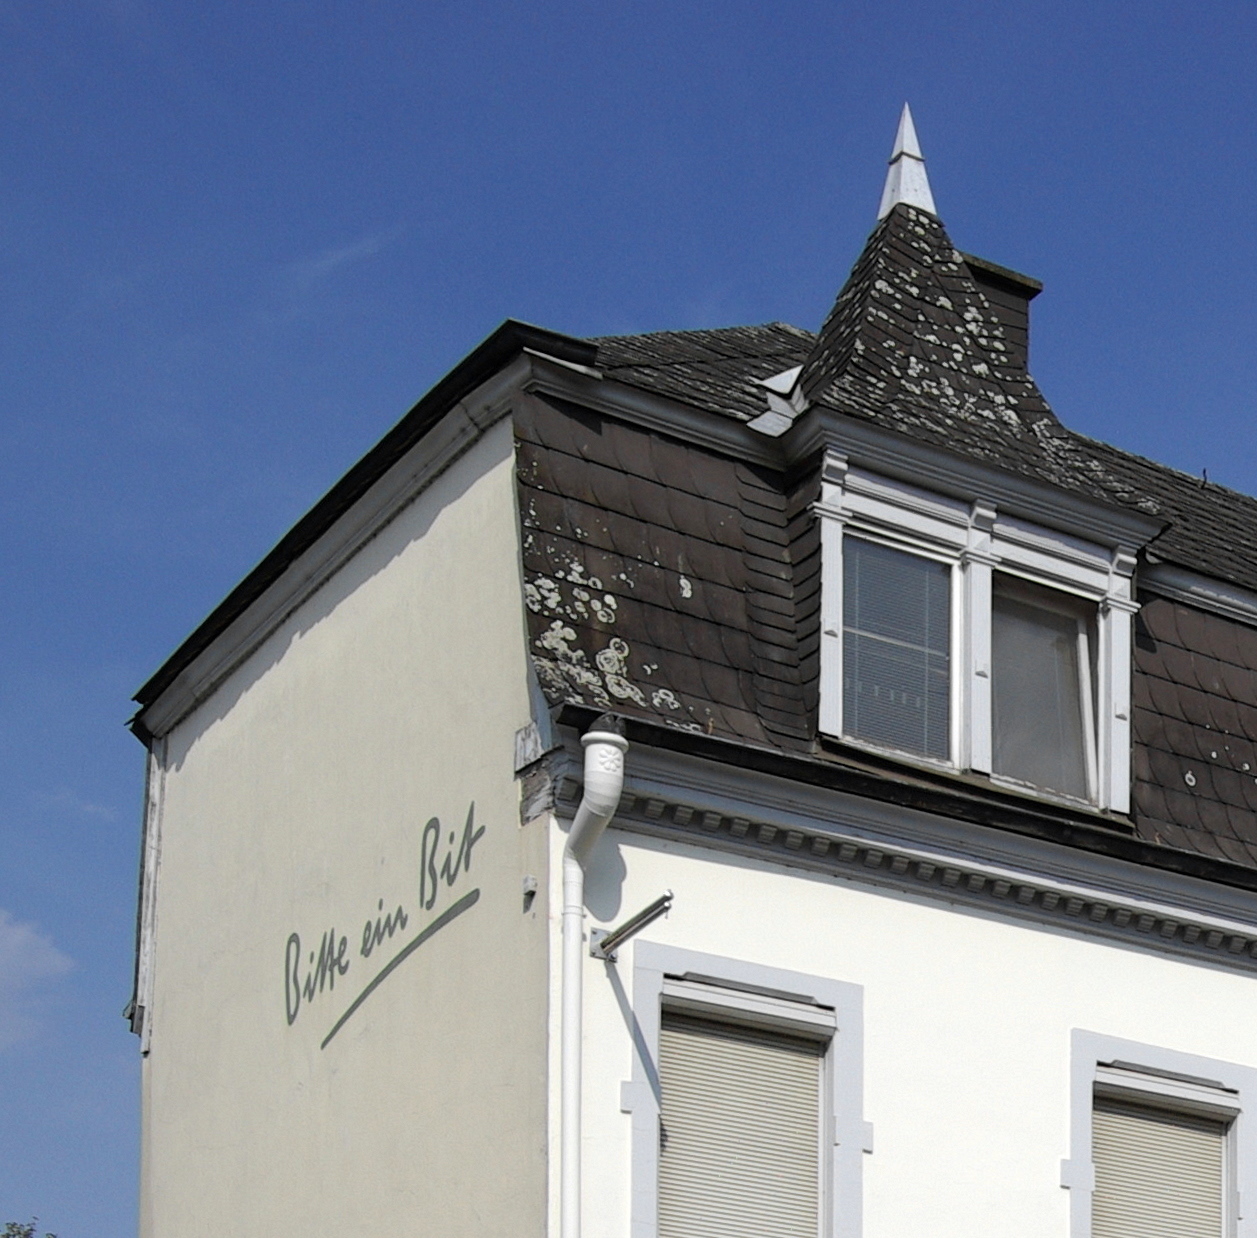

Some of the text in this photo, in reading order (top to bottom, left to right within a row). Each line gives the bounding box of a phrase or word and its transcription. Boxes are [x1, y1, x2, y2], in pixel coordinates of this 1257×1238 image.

[285, 800, 485, 1026] Bitte ein Bit
